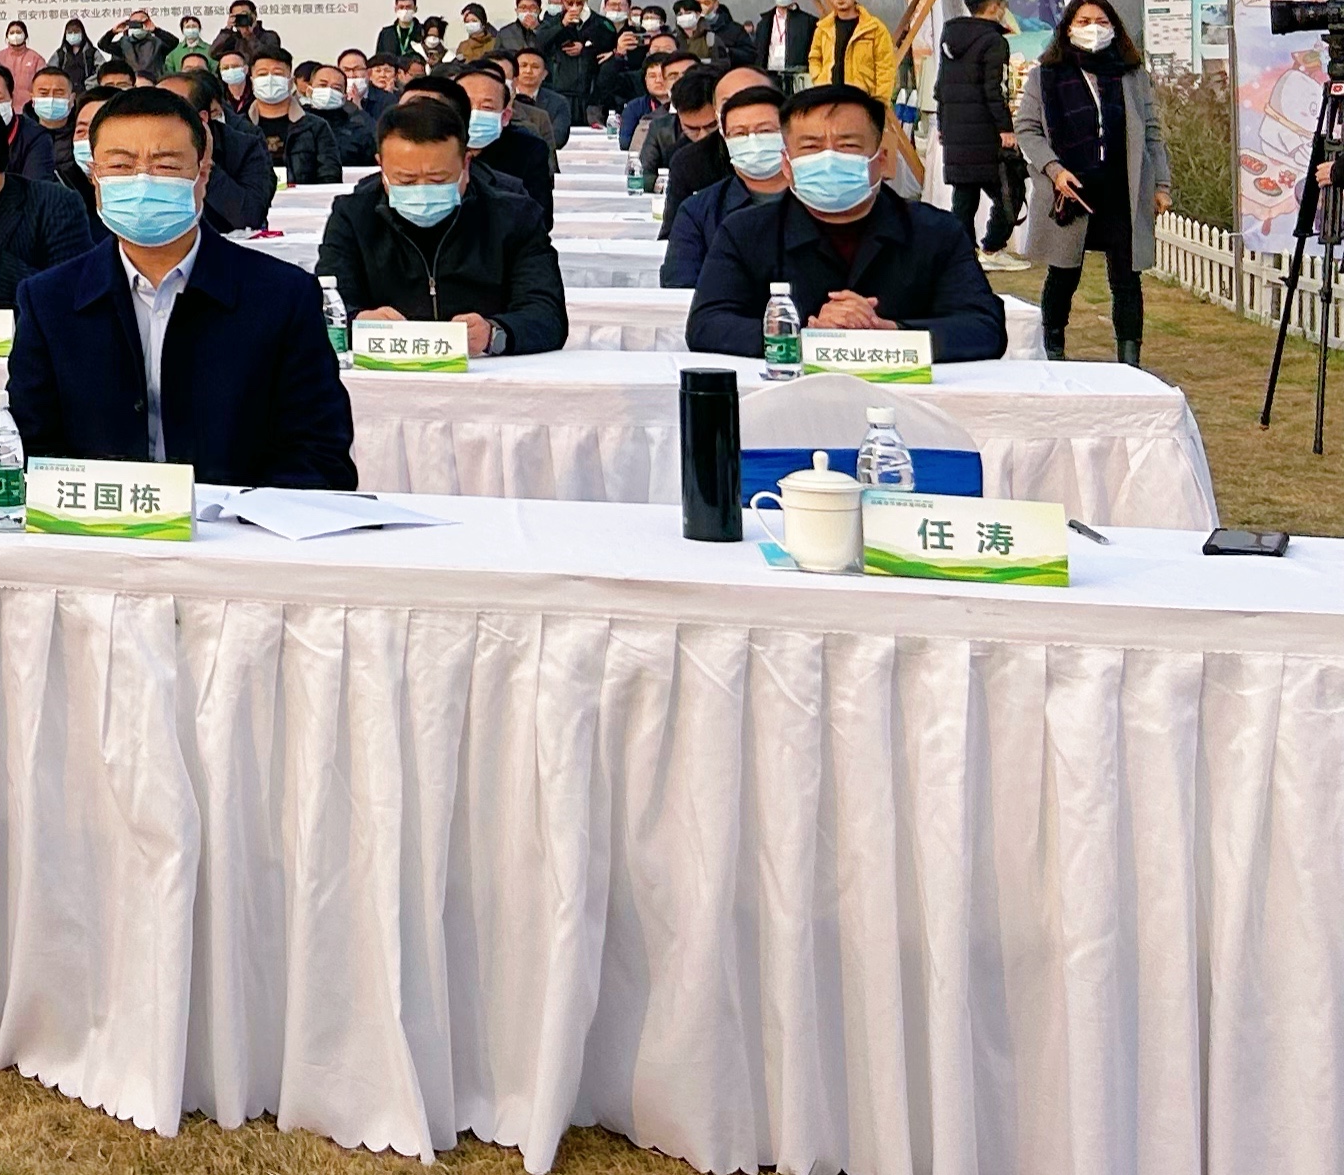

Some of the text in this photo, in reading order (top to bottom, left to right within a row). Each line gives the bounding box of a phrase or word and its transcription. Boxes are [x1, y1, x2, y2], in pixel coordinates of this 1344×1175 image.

[368, 337, 453, 356] 区政府办
[815, 347, 919, 365] 区农业农村局
[56, 479, 162, 514] 汪国栋
[917, 517, 1015, 556] 任涛
